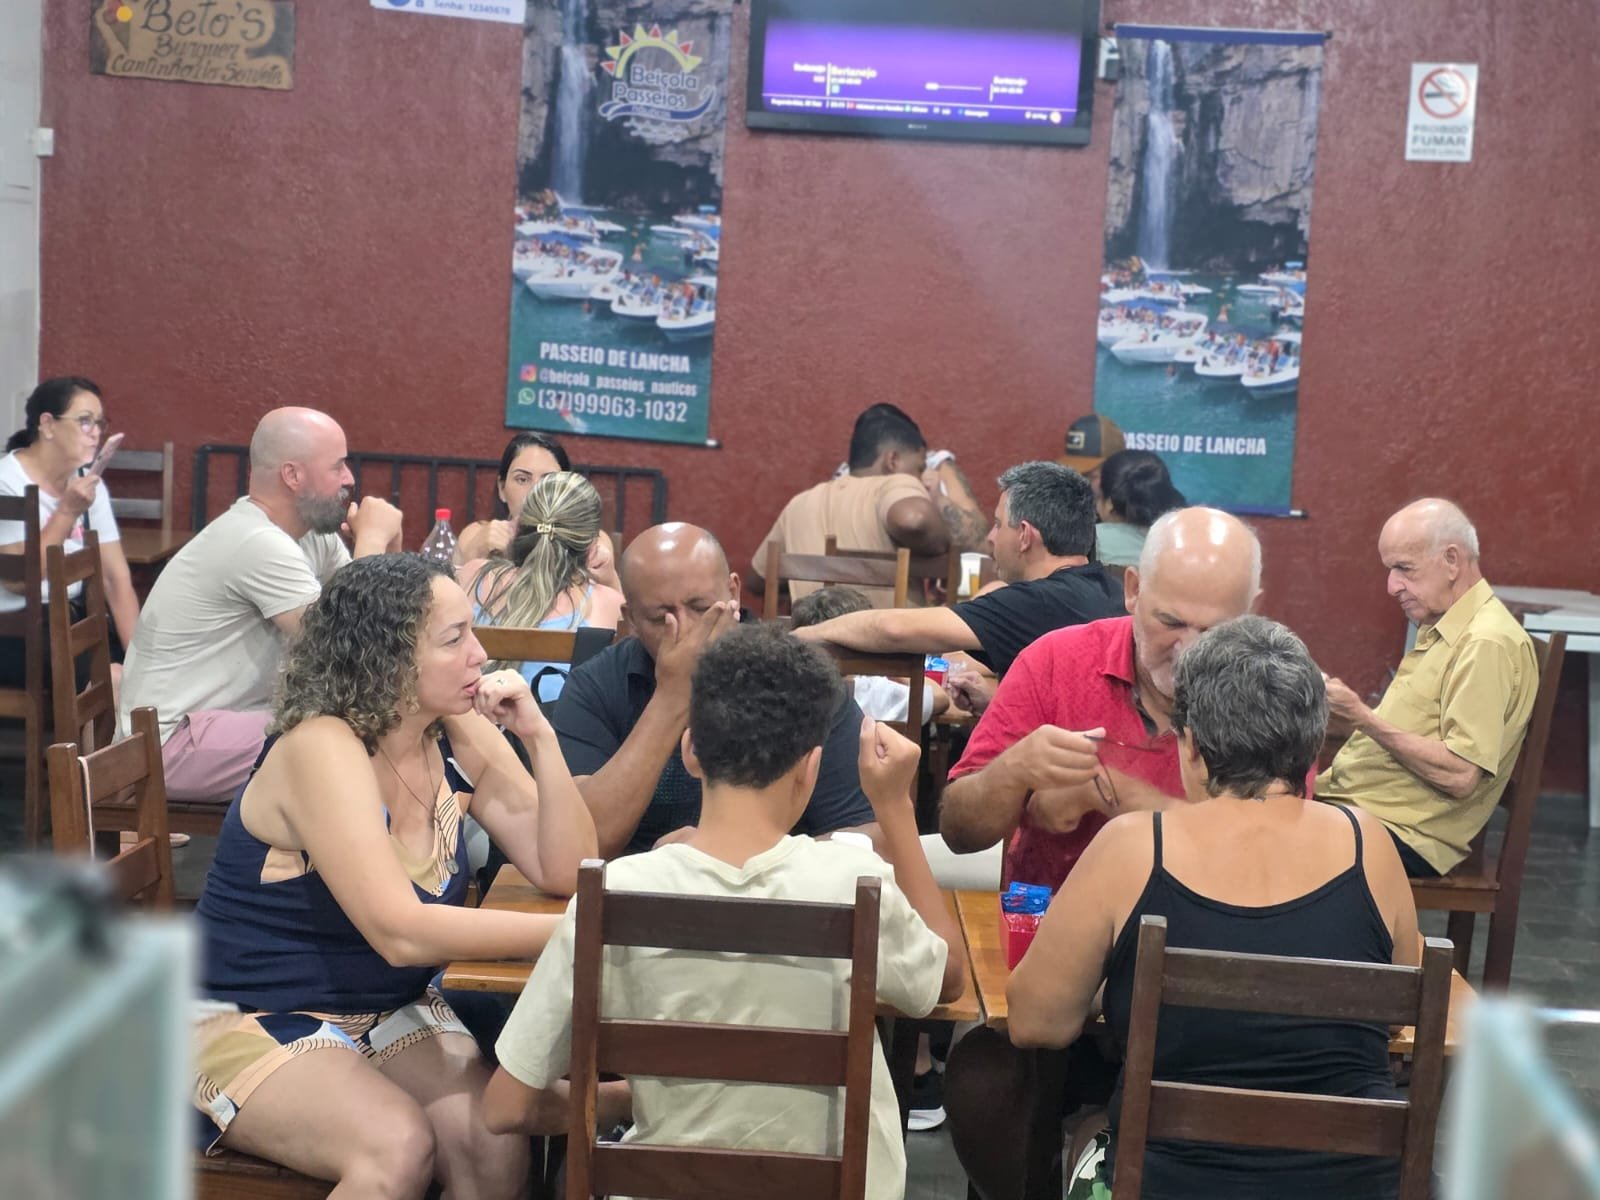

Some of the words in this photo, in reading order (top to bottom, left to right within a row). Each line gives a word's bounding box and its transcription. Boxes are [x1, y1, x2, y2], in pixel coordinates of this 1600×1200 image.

[631, 64, 697, 90] Beiçola
[613, 81, 686, 109] Passeios
[540, 341, 604, 365] PASSEIO
[607, 349, 626, 368] DE
[629, 351, 690, 373] LANCHA
[538, 388, 688, 423] (37)99963-1032
[1123, 432, 1179, 452] ASSEIO
[1183, 435, 1203, 453] DE
[1205, 436, 1267, 455] LANCHA
